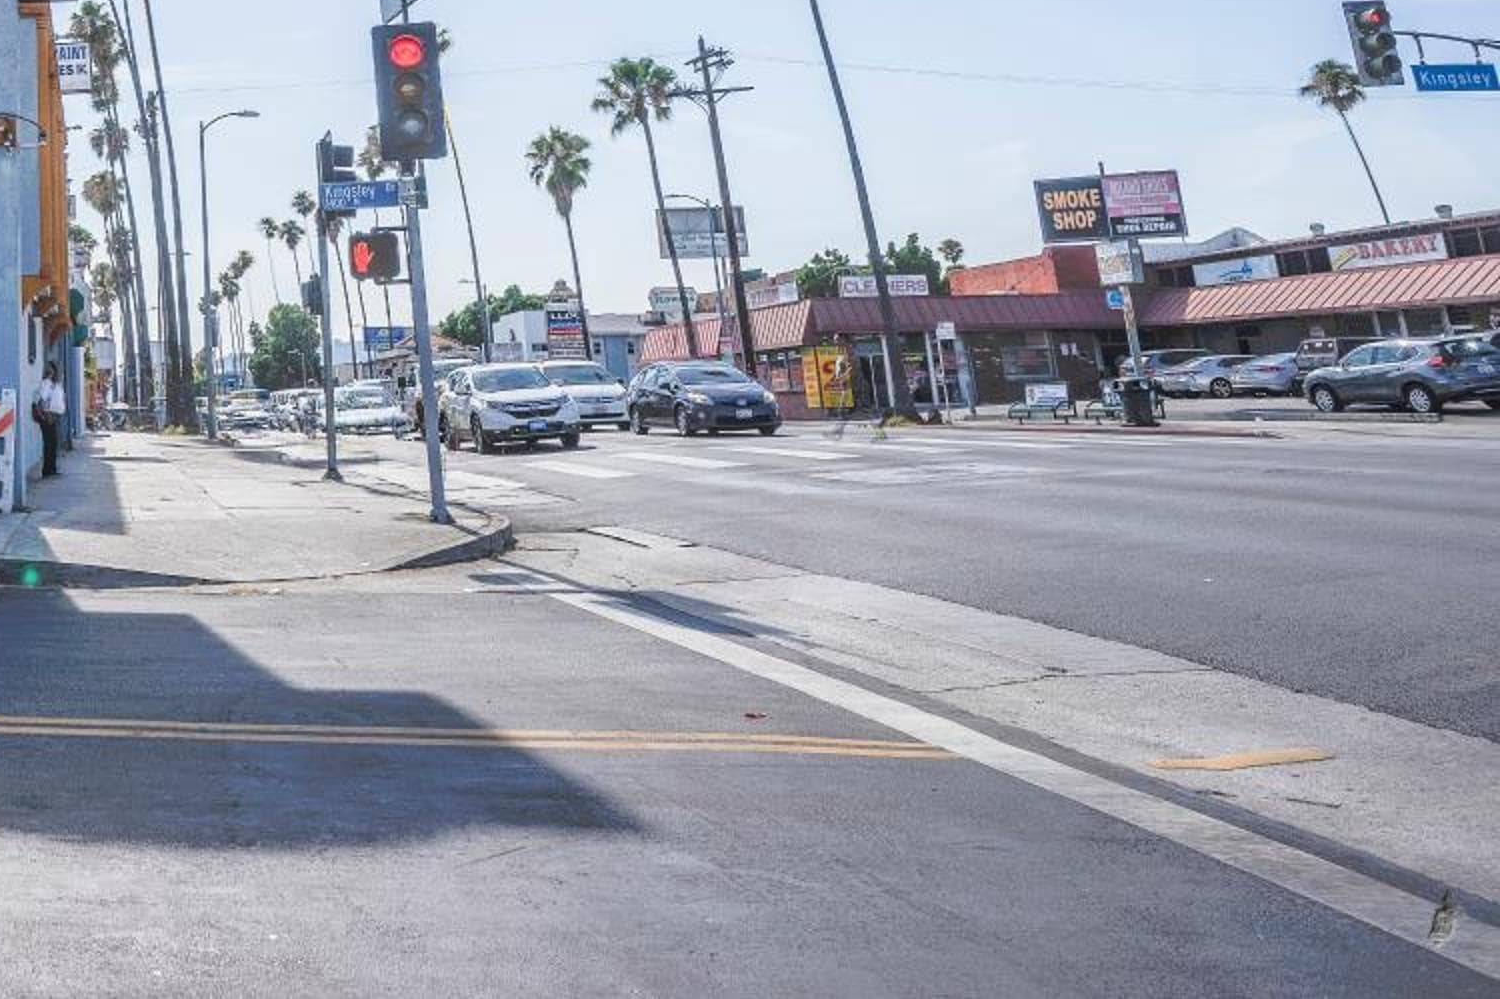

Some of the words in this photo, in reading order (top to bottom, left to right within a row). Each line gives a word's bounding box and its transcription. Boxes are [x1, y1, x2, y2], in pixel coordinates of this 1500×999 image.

[58, 45, 87, 60] AINT
[1419, 70, 1492, 88] Kingsley
[324, 184, 376, 201] Kingsley
[1043, 188, 1101, 210] SMOKE
[1053, 209, 1097, 230] SHOP
[1359, 234, 1438, 259] BAKERY
[844, 280, 929, 294] CLEERS
